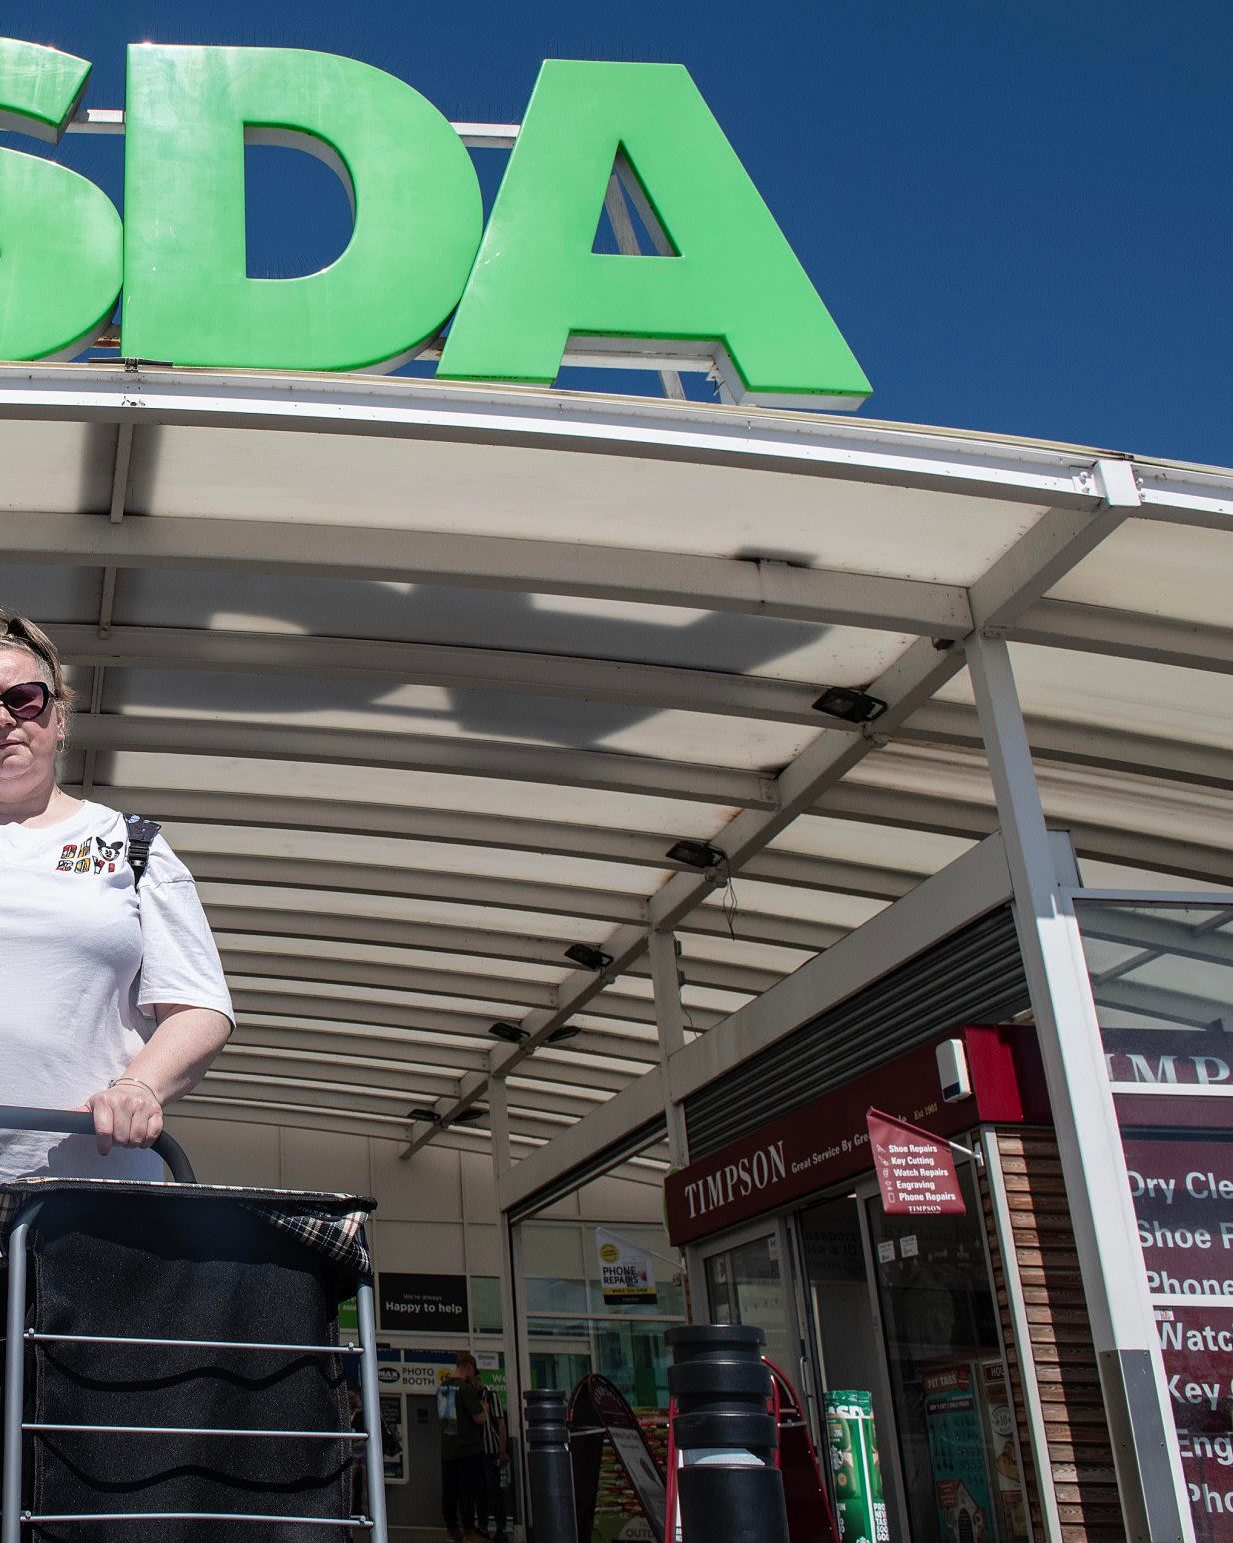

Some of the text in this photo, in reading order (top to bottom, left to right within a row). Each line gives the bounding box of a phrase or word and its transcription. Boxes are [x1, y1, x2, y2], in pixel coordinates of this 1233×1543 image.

[888, 1144, 938, 1155] Shoe Repairs
[891, 1156, 935, 1166] Key Cutting
[893, 1168, 949, 1177] Watch Repairs
[684, 1140, 788, 1219] TIMPSON
[791, 1157, 812, 1174] Great
[812, 1145, 840, 1165] Service
[841, 1139, 852, 1153] By
[896, 1180, 936, 1190] Engraving
[898, 1192, 956, 1202] Phone Repairs
[1136, 1219, 1212, 1249] Shoe
[602, 1266, 636, 1276] PHONE
[603, 1275, 639, 1285] REPAIRS
[385, 1301, 463, 1314] Happy to help
[402, 1367, 434, 1377] PHOTO
[402, 1376, 435, 1386] BOOTH
